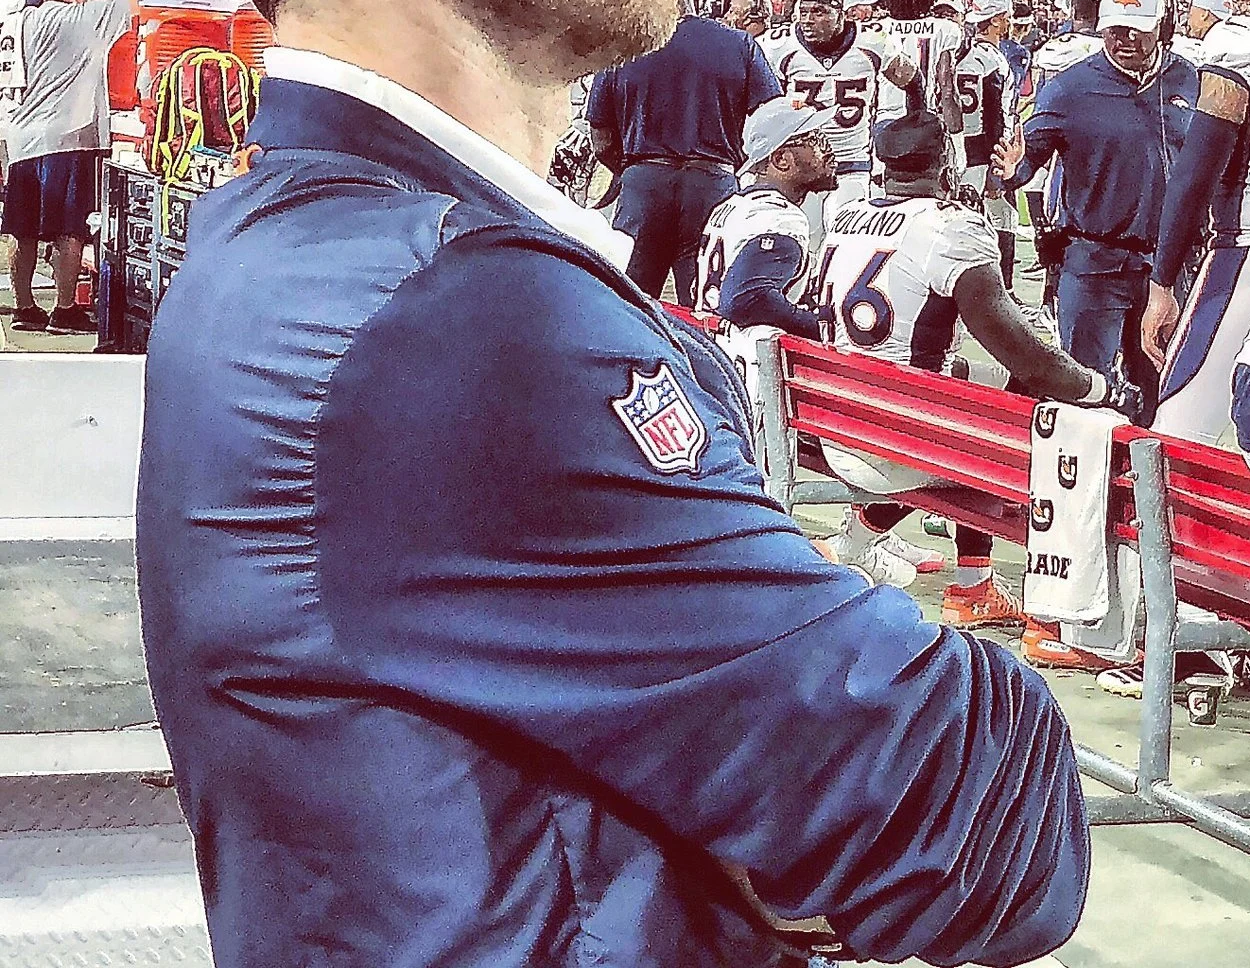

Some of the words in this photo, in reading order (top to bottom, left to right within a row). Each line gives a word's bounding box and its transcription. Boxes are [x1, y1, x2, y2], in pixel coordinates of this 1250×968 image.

[888, 20, 935, 35] ADOM
[793, 76, 870, 129] 35
[644, 408, 696, 457] NFL
[1188, 691, 1208, 716] G
